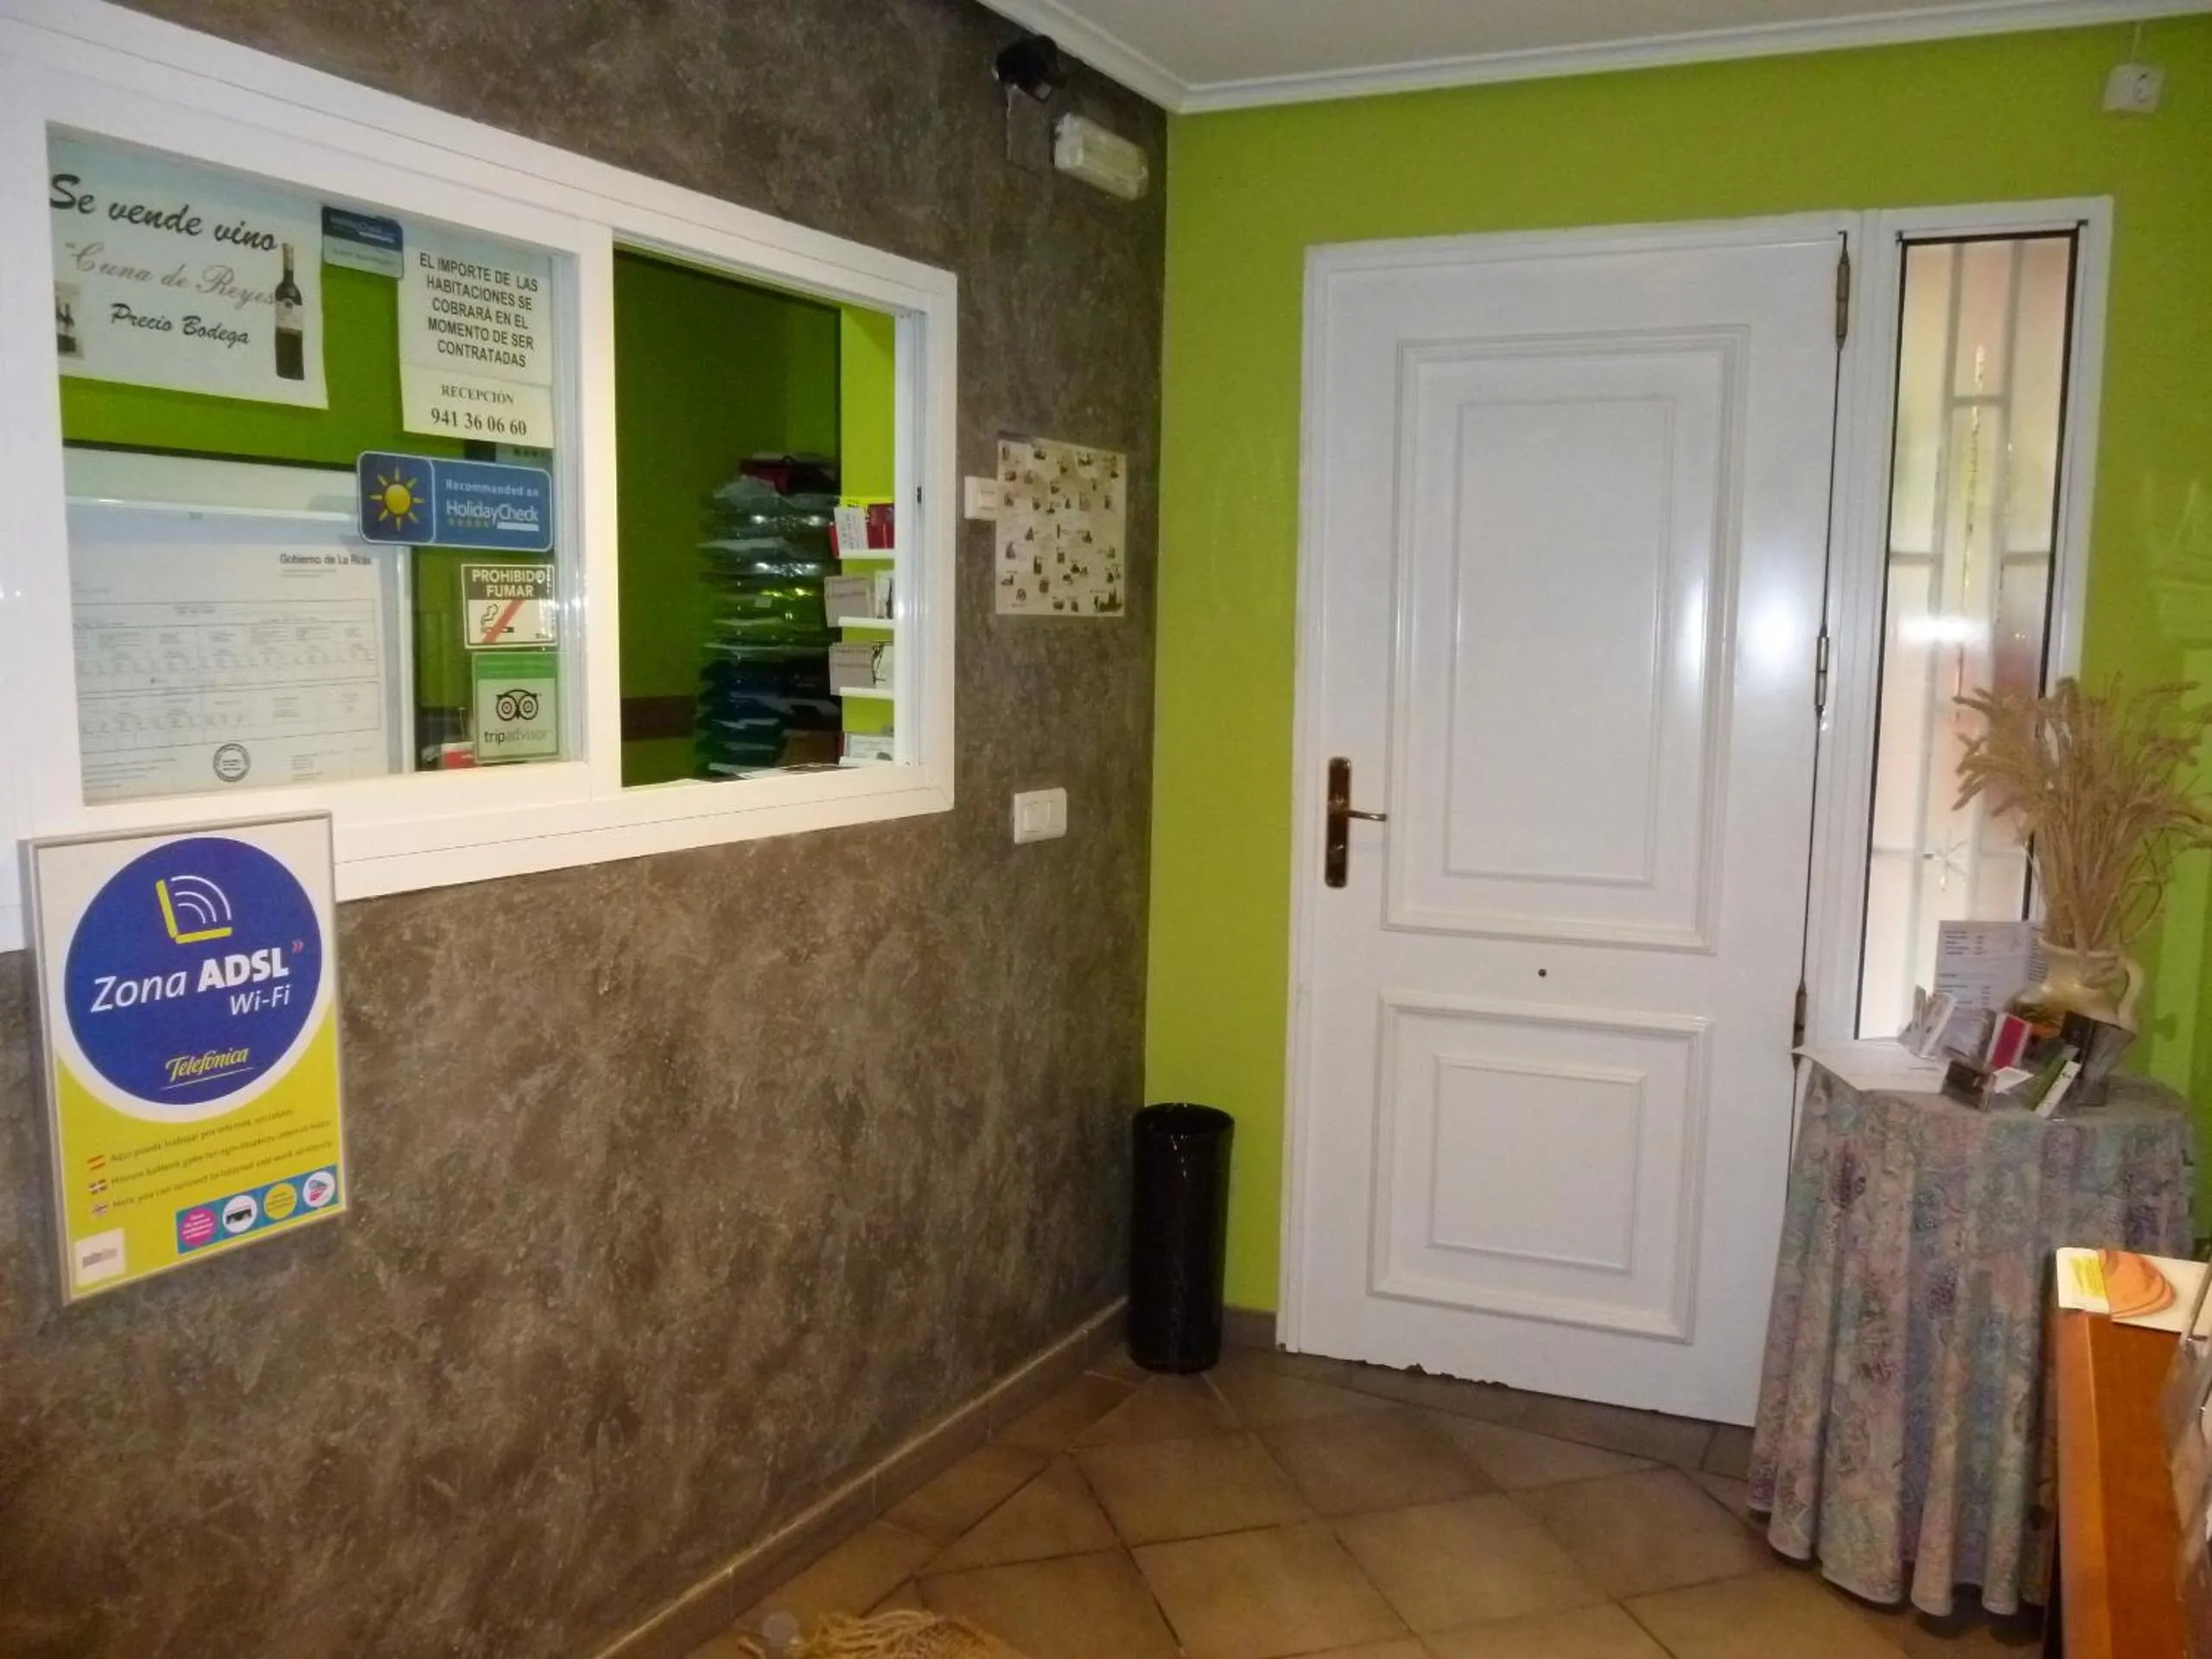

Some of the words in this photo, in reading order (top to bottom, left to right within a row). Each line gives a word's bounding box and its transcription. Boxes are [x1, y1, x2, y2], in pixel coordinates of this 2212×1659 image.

[49, 174, 96, 214] Se
[109, 204, 202, 236] vende
[214, 220, 277, 251] vino
[161, 264, 188, 289] de
[420, 252, 435, 269] EL
[437, 257, 492, 282] IMPORTE
[495, 270, 511, 286] DE
[516, 276, 538, 292] LAS
[427, 275, 515, 308] HABITACIONES
[518, 296, 532, 311] SE
[111, 302, 174, 332] Precio
[182, 315, 251, 348] Bodega
[495, 310, 512, 327] EN
[514, 315, 529, 329] EL
[428, 317, 489, 341] MOMENTO
[493, 330, 509, 345] DE
[511, 333, 534, 350] SER
[437, 340, 526, 368] CONTRATADAS
[431, 408, 458, 428] 941
[464, 412, 482, 430] 36
[487, 416, 505, 434] 06
[510, 419, 527, 435] 60
[445, 479, 524, 497] Recommended
[446, 499, 539, 525] HolidayCheck
[324, 554, 335, 564] de
[472, 569, 546, 584] PROHIBIDO
[486, 584, 534, 598] FUMAR
[90, 971, 188, 1013] Zona
[197, 948, 289, 993] ADSL
[230, 984, 291, 1016] Wi-Fi
